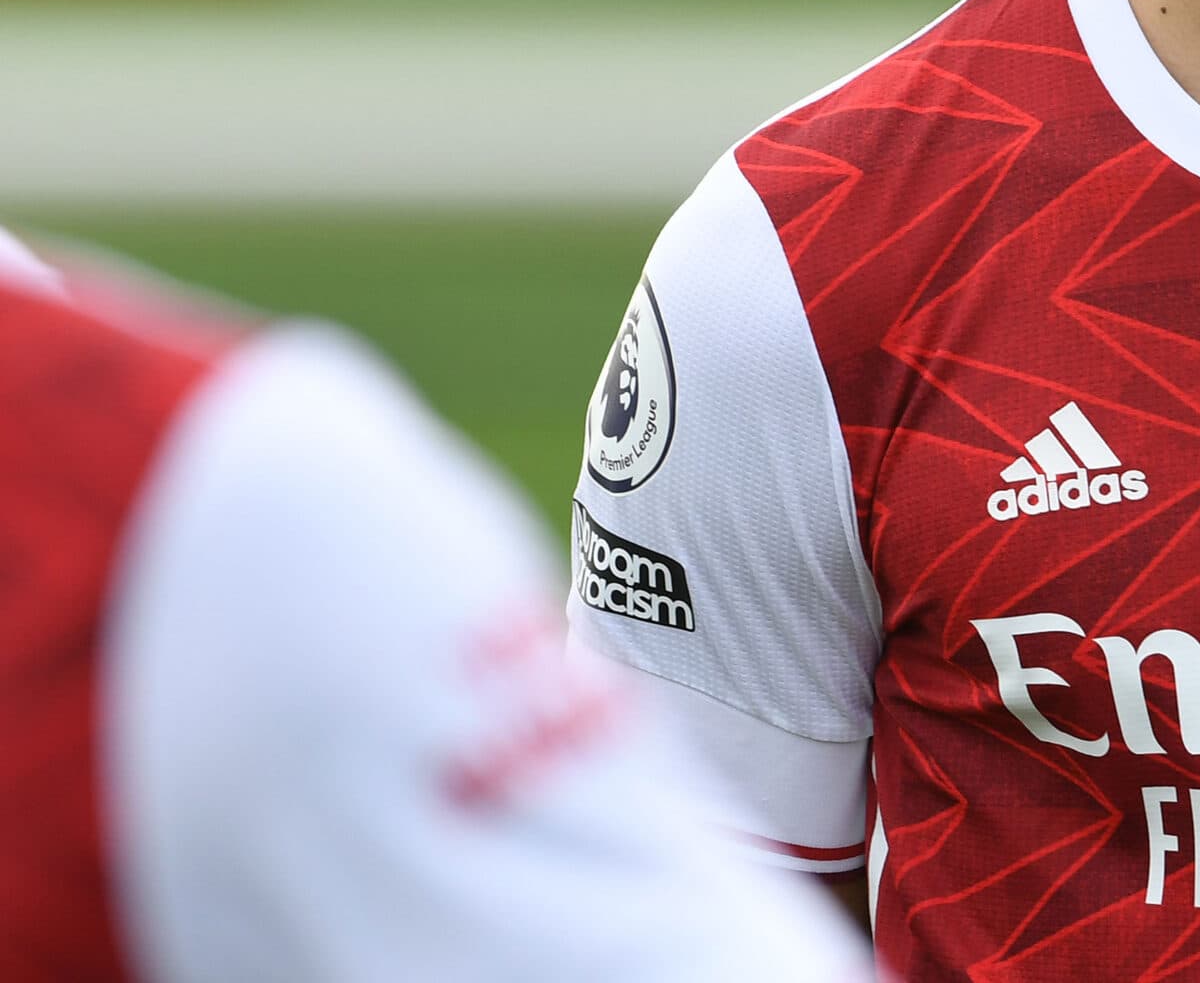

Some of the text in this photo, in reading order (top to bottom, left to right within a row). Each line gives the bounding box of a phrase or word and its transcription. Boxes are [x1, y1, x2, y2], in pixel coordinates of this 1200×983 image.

[600, 399, 658, 472] Premier League
[987, 468, 1149, 521] adidas
[588, 530, 673, 592] room
[582, 565, 694, 630] racism
